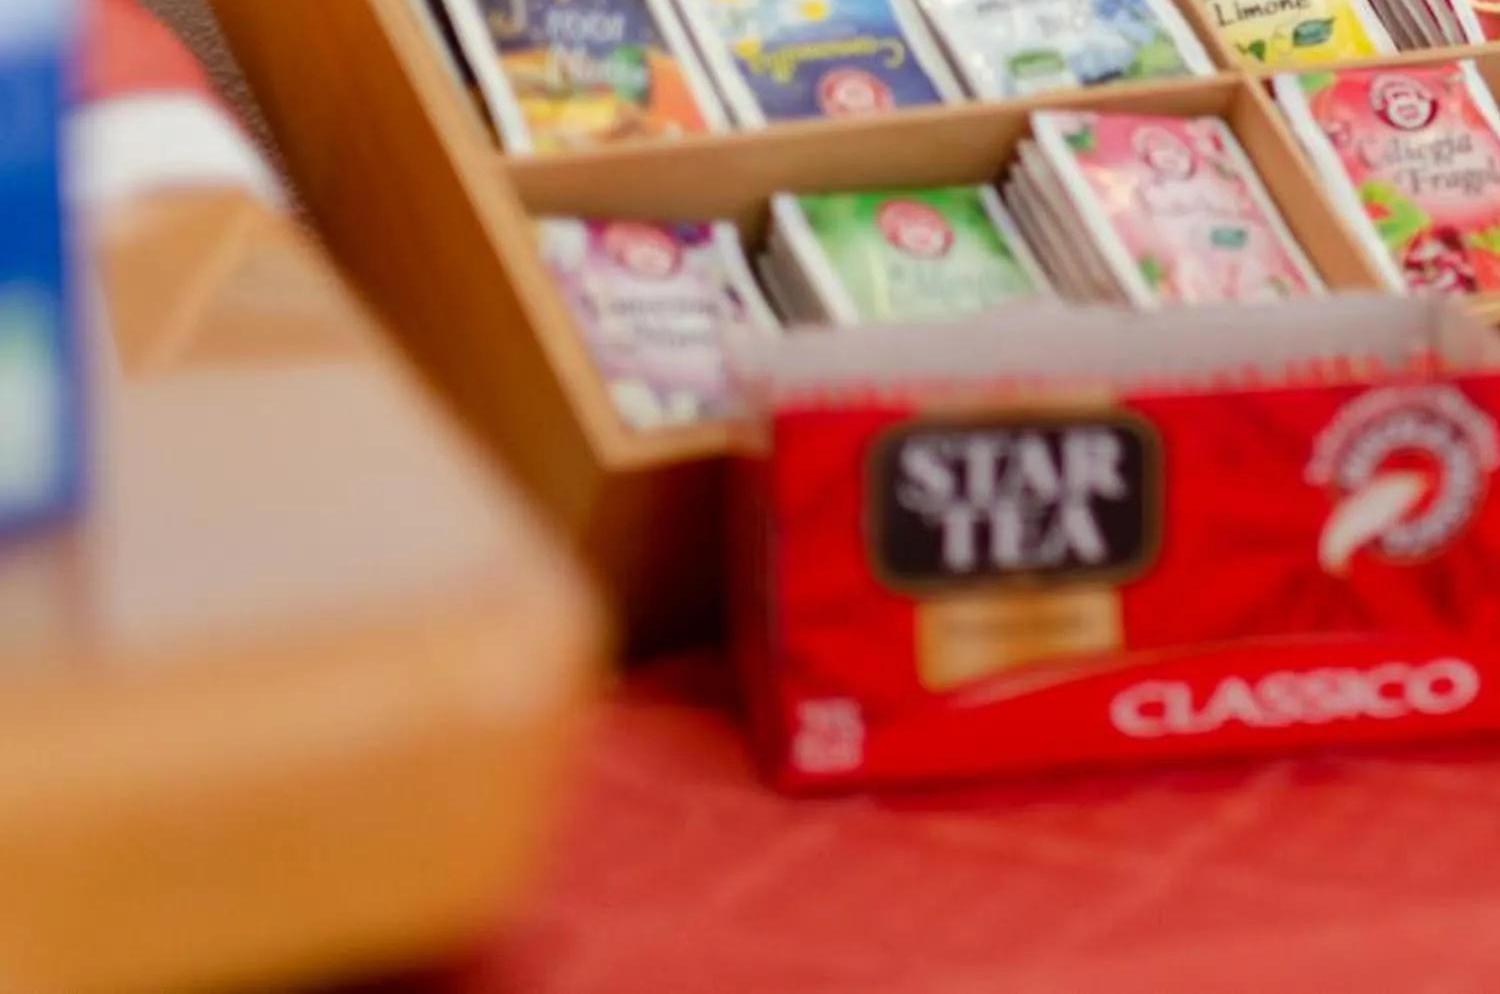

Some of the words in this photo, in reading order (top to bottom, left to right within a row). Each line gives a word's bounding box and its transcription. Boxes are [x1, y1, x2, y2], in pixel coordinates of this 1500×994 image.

[896, 427, 1128, 516] STAR
[930, 494, 1107, 573] TEA
[1109, 657, 1481, 738] CLASSICO
